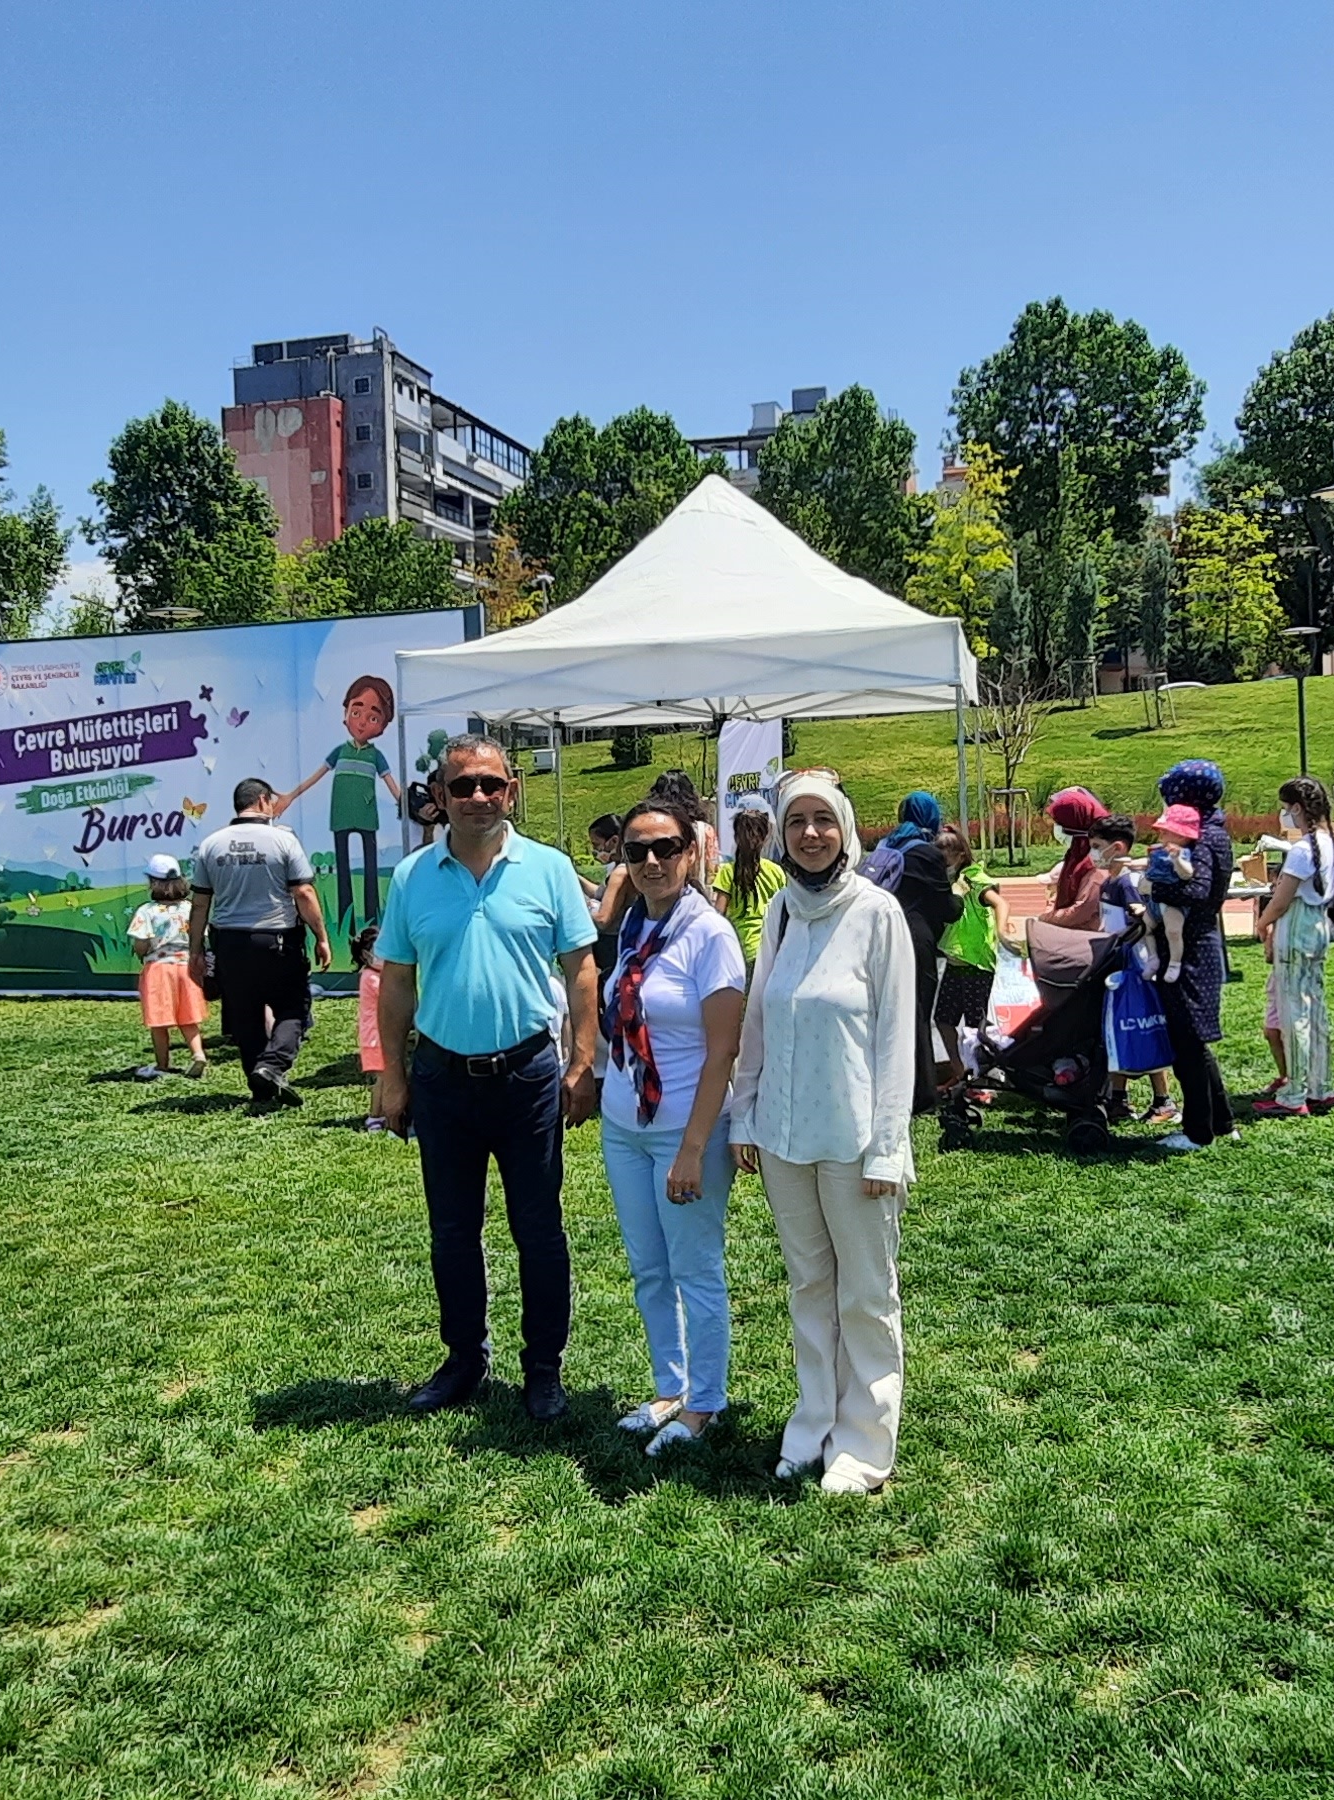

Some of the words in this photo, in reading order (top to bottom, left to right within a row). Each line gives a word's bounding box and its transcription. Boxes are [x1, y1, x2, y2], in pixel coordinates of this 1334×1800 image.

[14, 729, 66, 758] Çevre
[69, 707, 178, 745] Müfettişleri
[50, 742, 142, 773] Buluşuyor
[40, 788, 74, 809] Doğa
[75, 776, 130, 801] Etkinliği
[73, 808, 186, 854] Bursa
[229, 840, 256, 852] ÖZEL
[1120, 1018, 1136, 1031] LC
